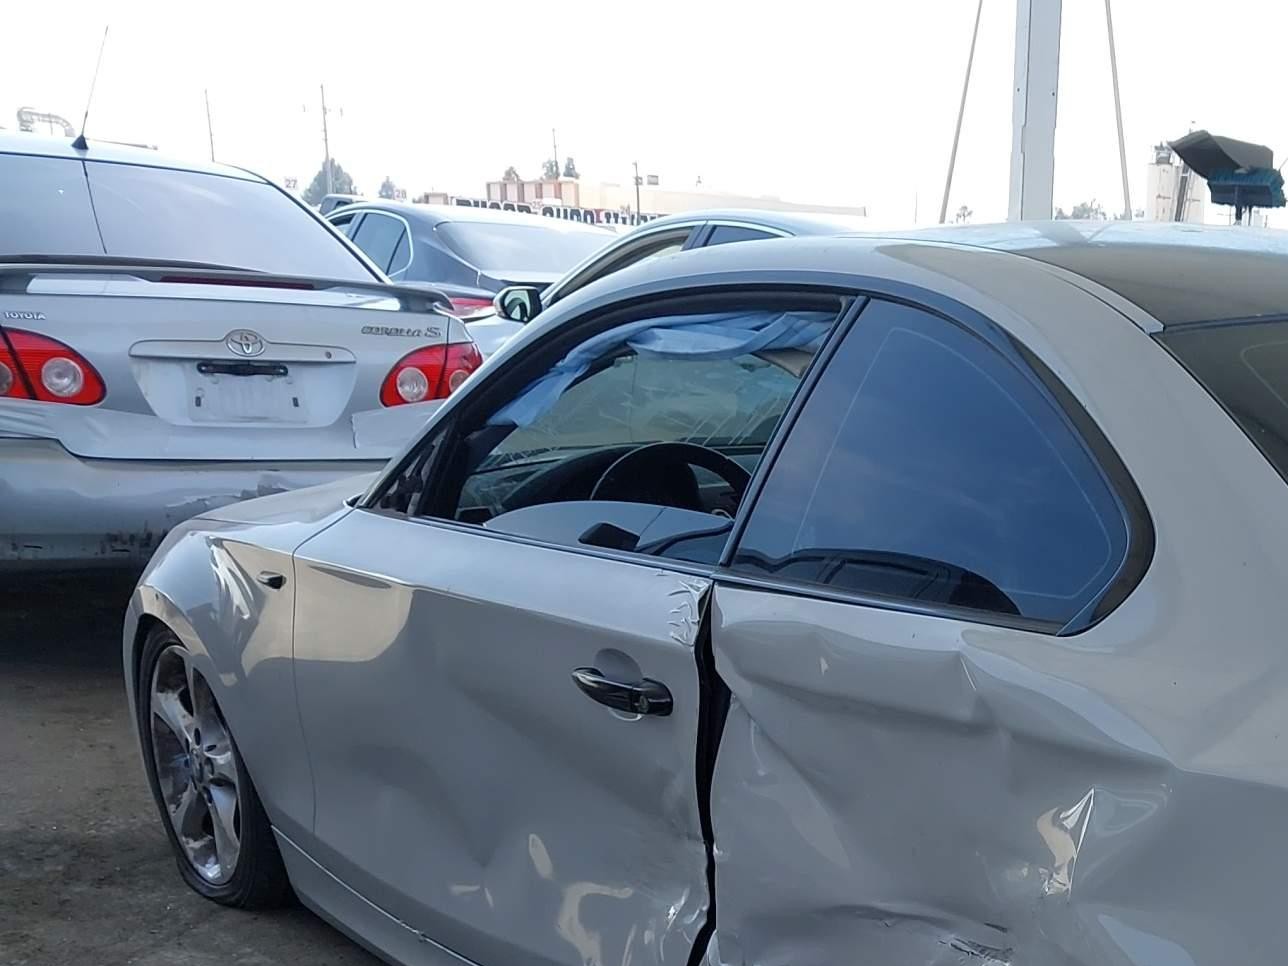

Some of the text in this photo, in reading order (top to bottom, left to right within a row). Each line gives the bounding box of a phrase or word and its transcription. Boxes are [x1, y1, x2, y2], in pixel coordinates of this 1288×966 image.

[285, 178, 298, 189] 27
[4, 311, 47, 321] TOYOTA
[361, 326, 442, 338] COROLLA S
